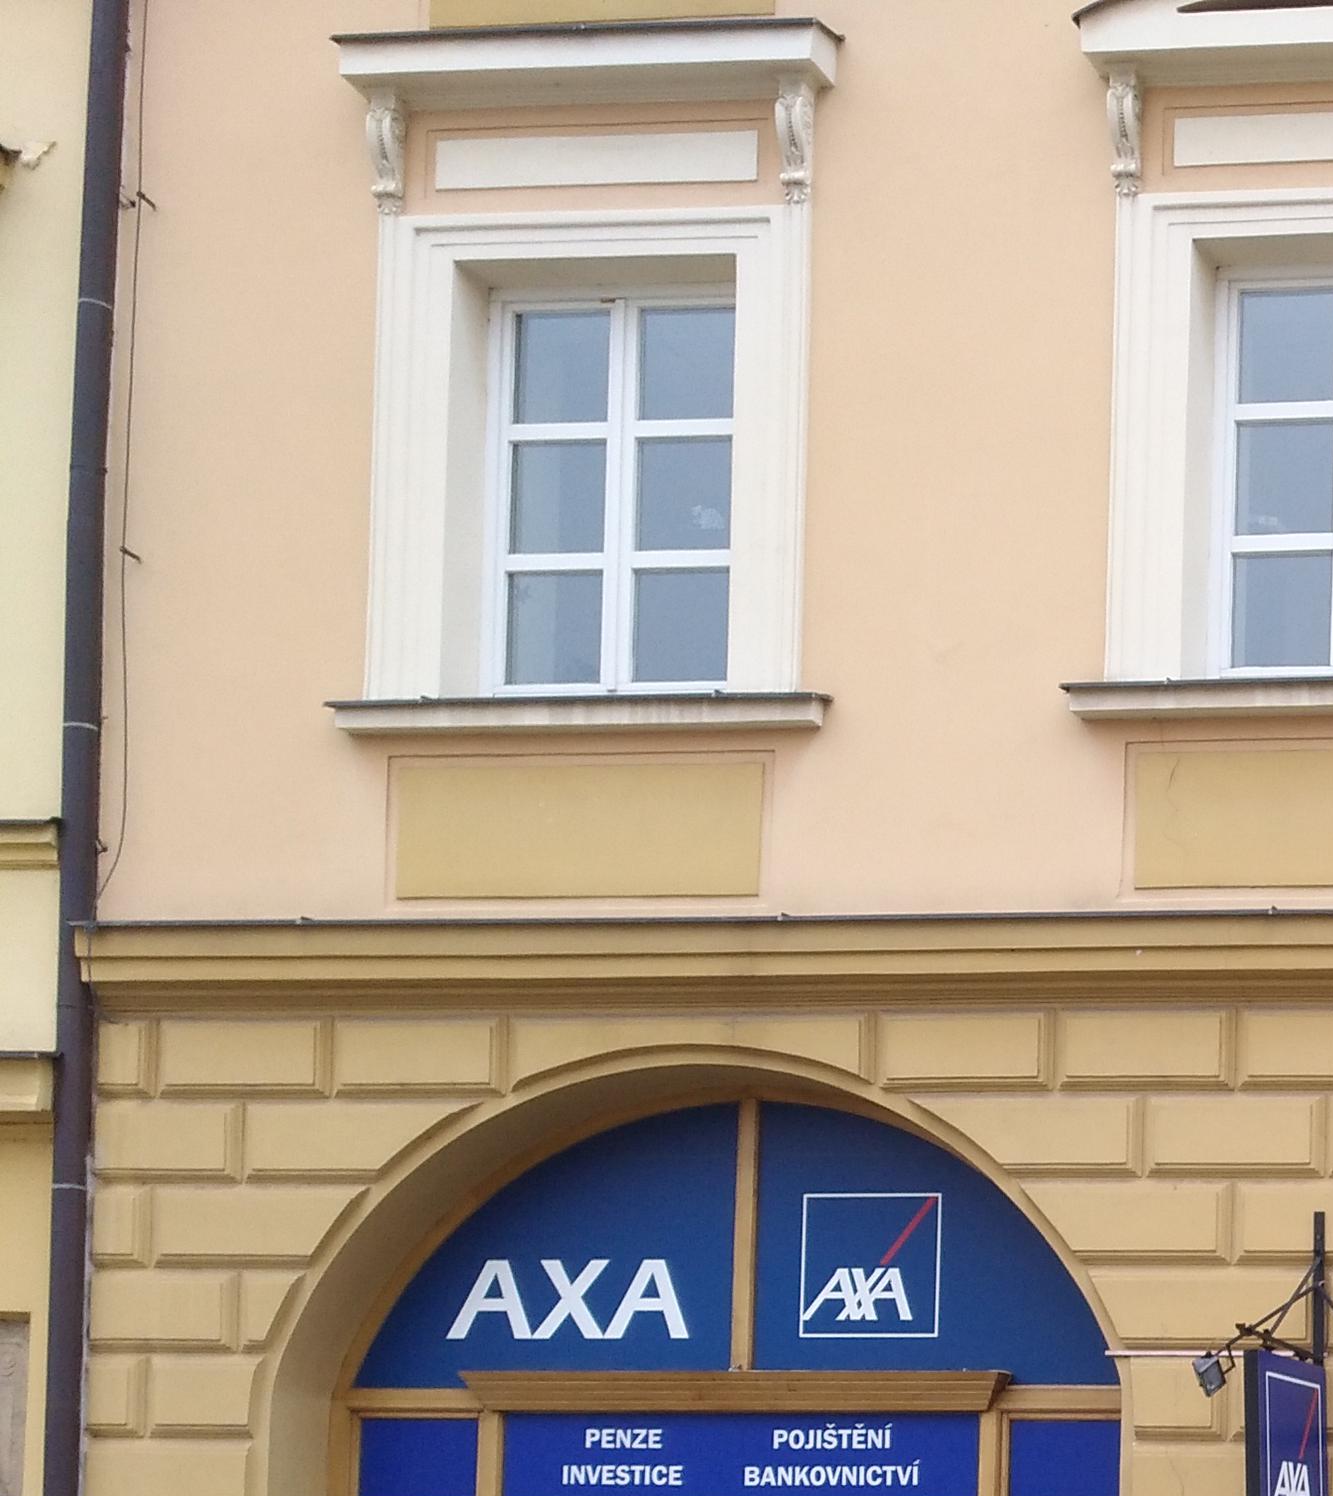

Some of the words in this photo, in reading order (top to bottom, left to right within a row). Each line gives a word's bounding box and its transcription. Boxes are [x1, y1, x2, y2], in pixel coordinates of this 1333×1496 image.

[445, 1259, 689, 1340] AXA
[801, 1266, 912, 1321] AXA
[584, 1428, 664, 1450] PENZE
[772, 1423, 892, 1452] POJIŠTĚNÍ
[561, 1464, 683, 1487] INVESTICE
[743, 1459, 919, 1488] BANKOVNICTVÍ
